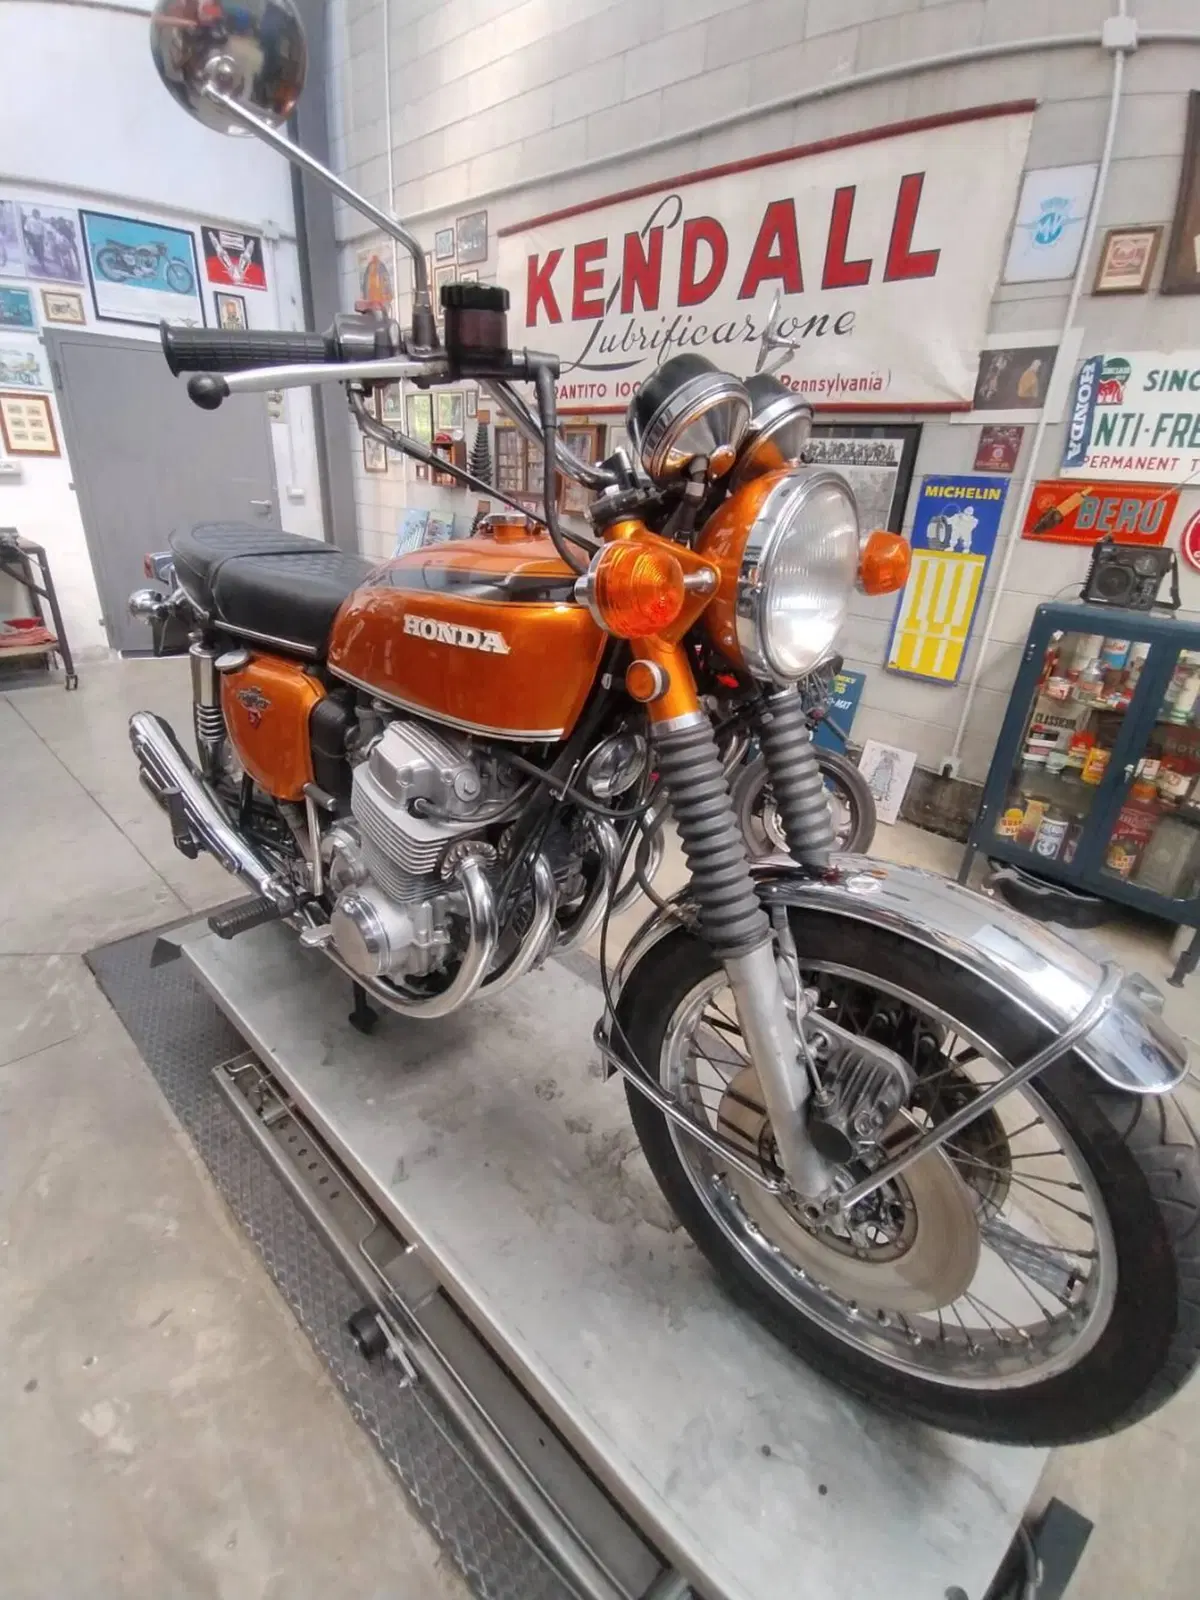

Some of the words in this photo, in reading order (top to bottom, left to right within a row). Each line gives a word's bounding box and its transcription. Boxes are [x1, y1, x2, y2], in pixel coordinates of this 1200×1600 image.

[526, 171, 941, 327] KENDALL
[533, 383, 607, 400] RANTITO
[1067, 361, 1096, 461] HONDA
[1093, 412, 1200, 449] NTI-FRE
[924, 485, 1002, 501] MICHELIN
[1074, 495, 1168, 535] BERU
[402, 613, 512, 655] HONDA
